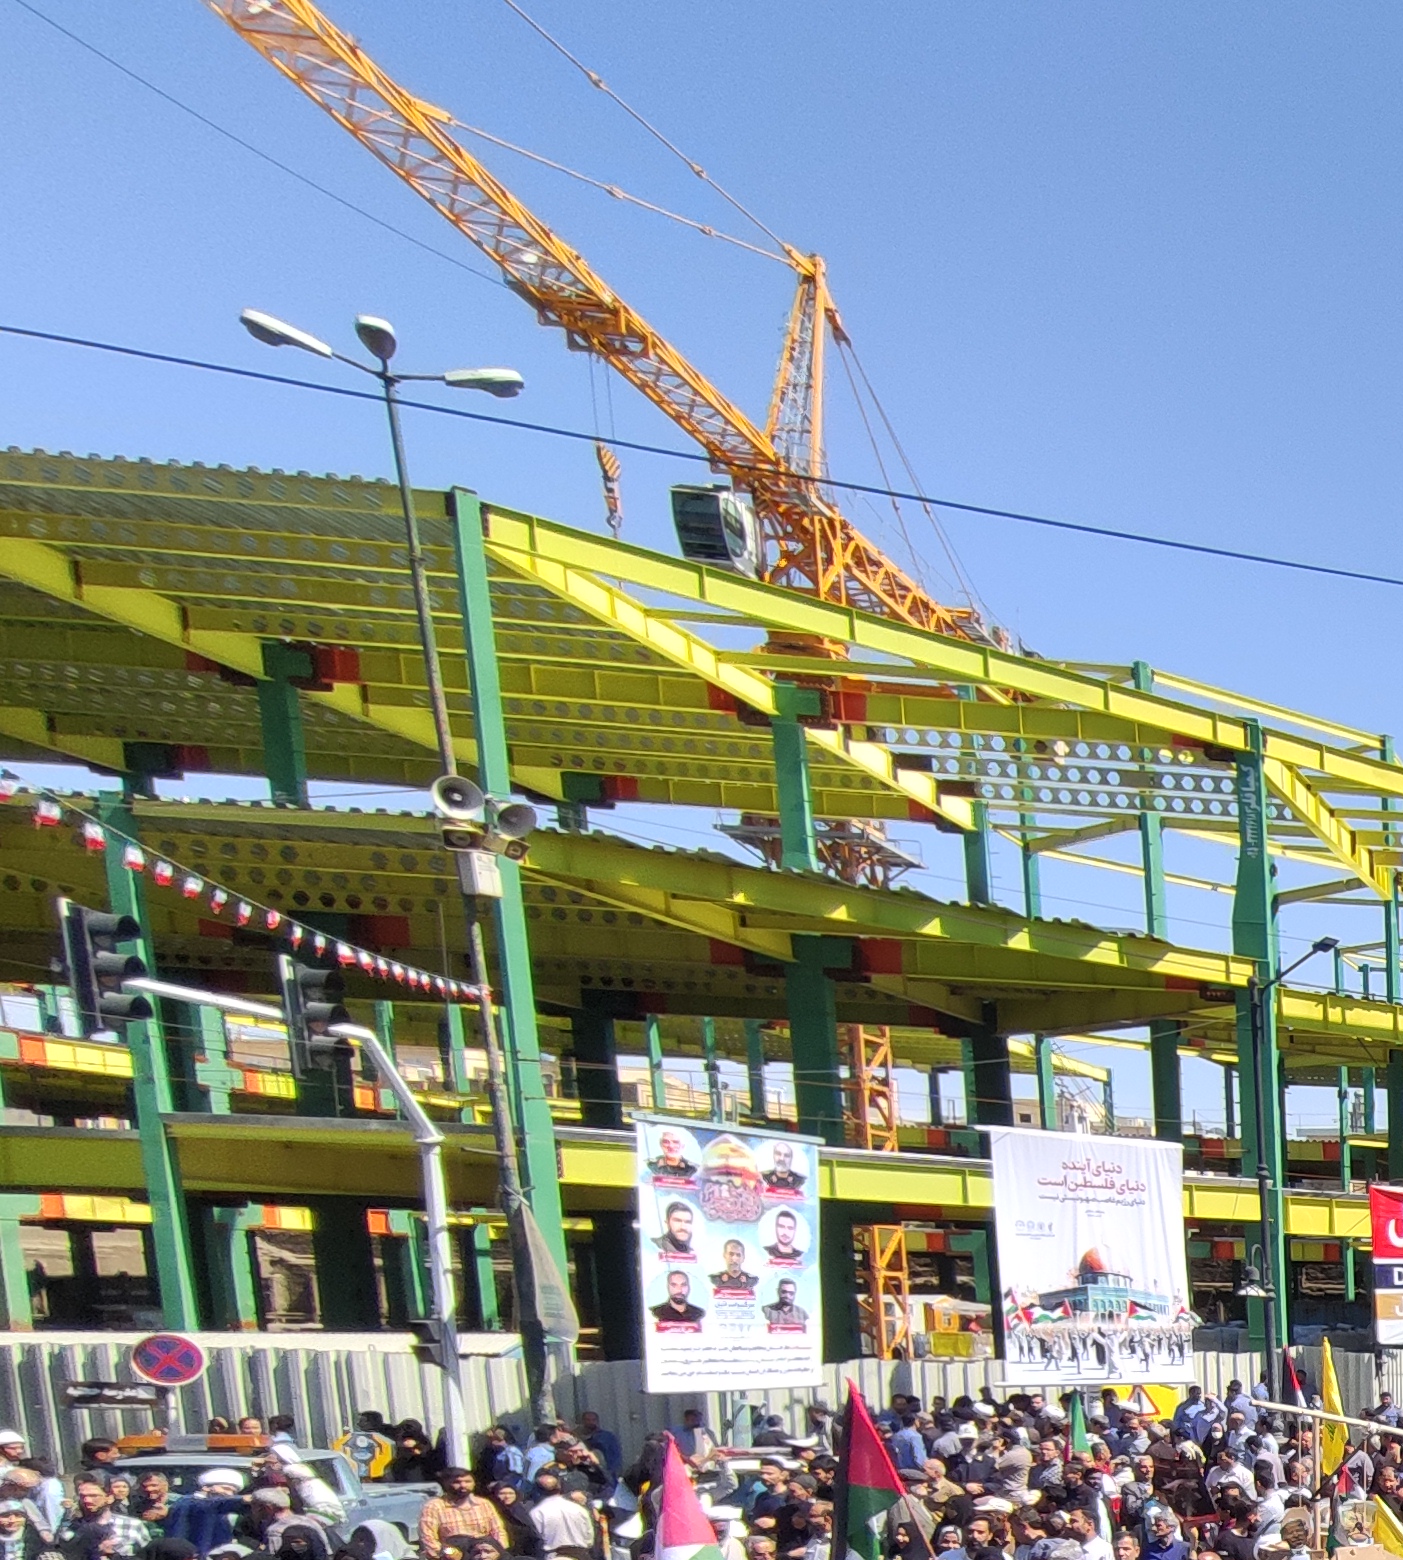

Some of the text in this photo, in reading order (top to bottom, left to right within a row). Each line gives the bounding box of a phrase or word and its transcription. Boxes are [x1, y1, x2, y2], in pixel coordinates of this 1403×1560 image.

[1062, 1158, 1122, 1177] دنیای آینده
[1037, 1175, 1146, 1195] دنیای فلسطین است
